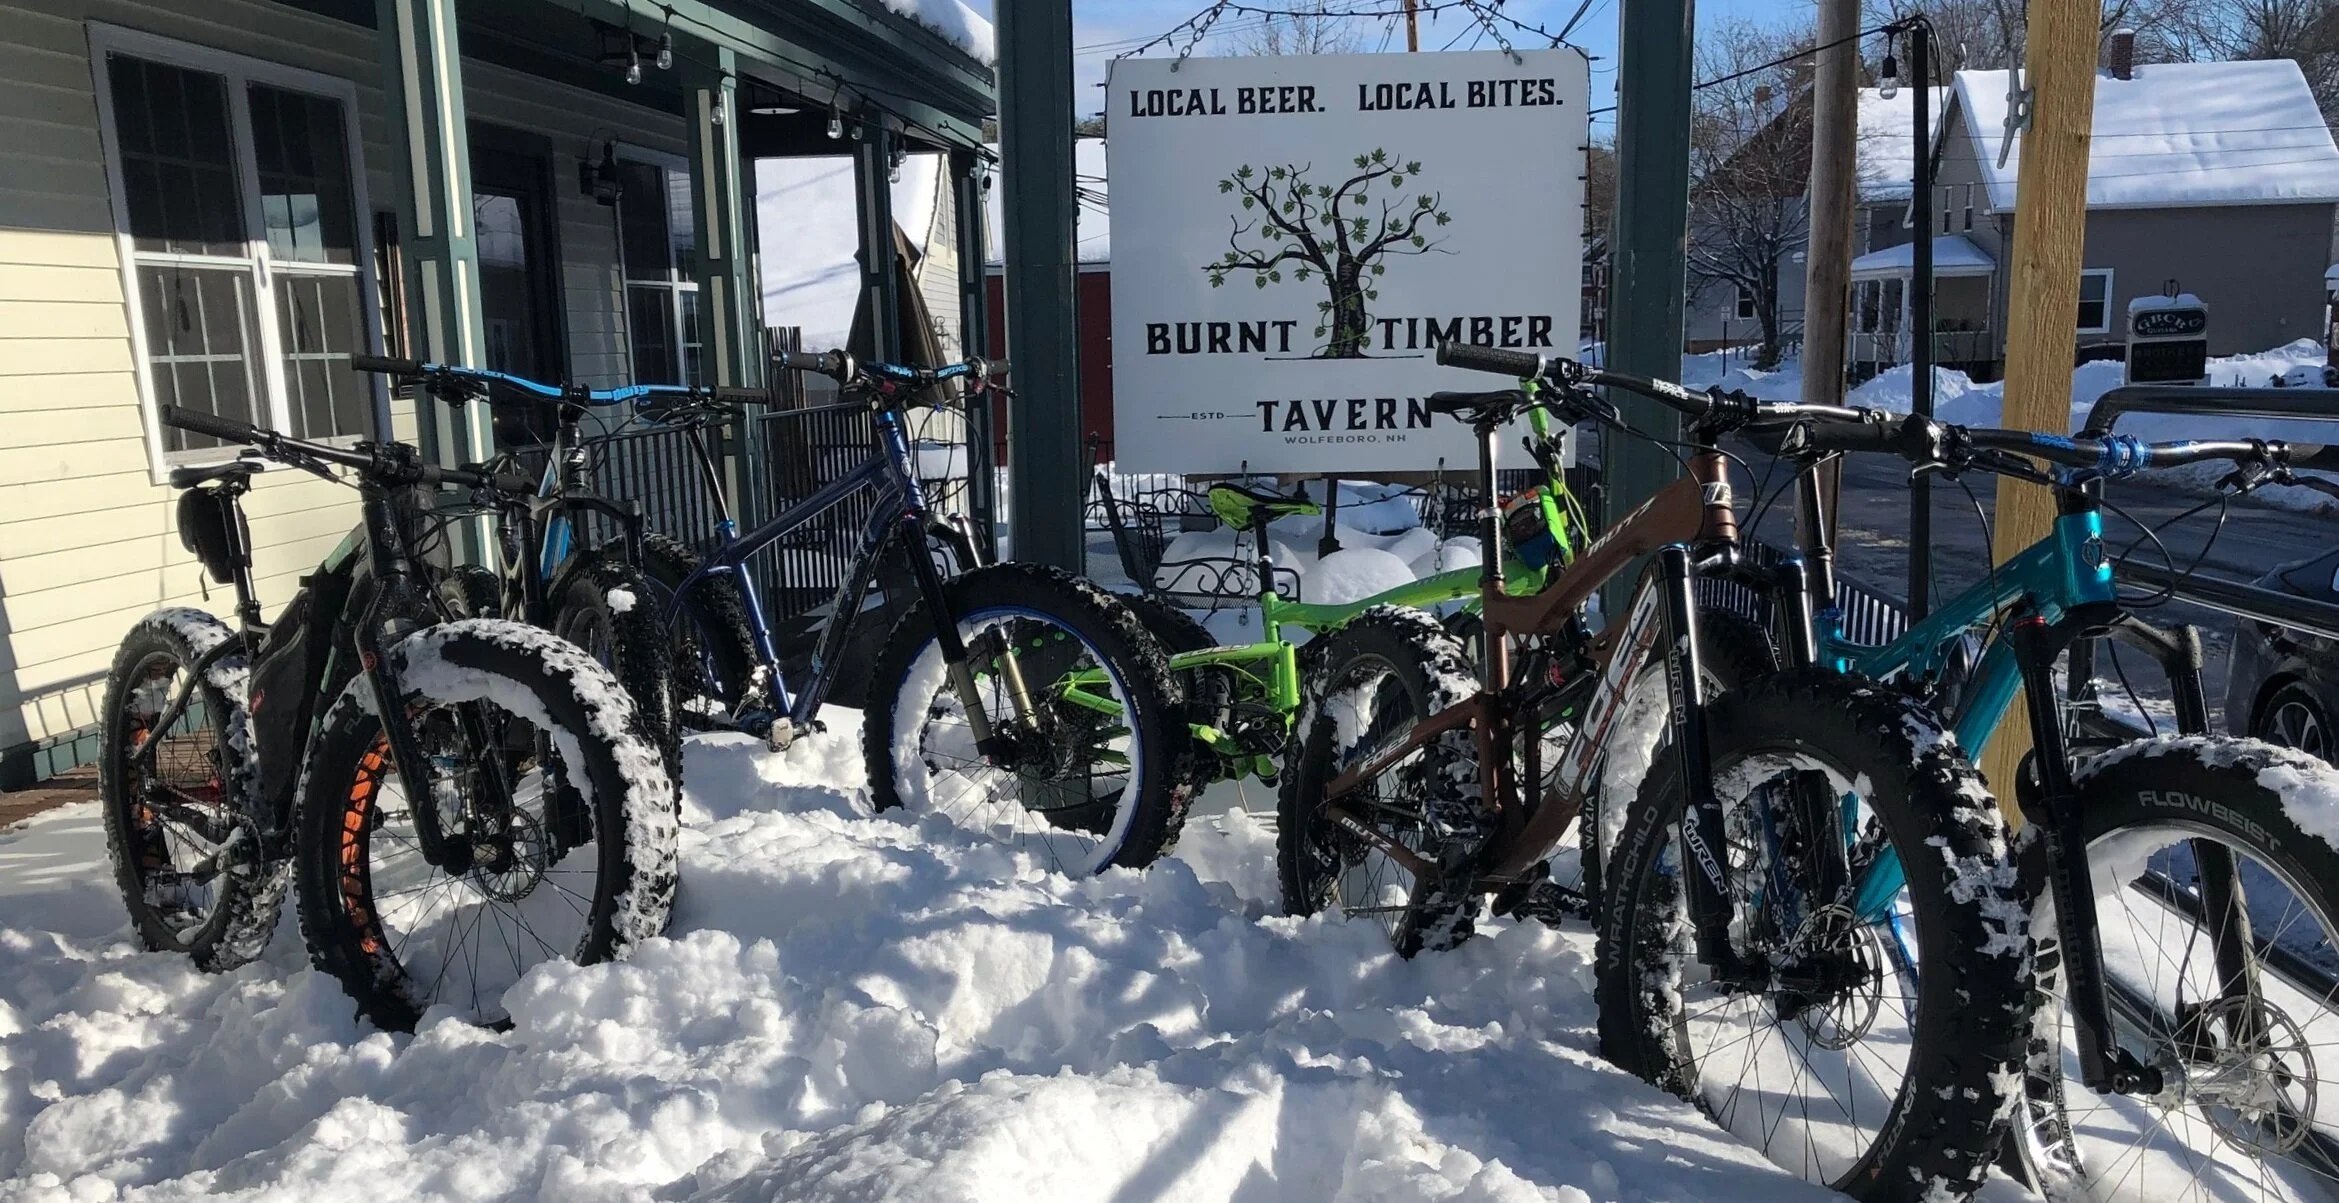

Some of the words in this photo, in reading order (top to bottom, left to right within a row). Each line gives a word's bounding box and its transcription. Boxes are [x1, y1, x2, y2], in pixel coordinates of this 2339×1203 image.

[1130, 88, 1226, 117] LOCAL
[1237, 86, 1325, 115] BEER.
[1358, 82, 1455, 111] LOCAL
[1467, 79, 1563, 107] BITES.
[1146, 320, 1297, 355] BURNT
[1376, 316, 1553, 350] TIMBER
[1191, 412, 1225, 420] ESTD
[1256, 398, 1432, 432] TAVERN
[1285, 435, 1381, 445] WOLFEBORO,
[1386, 434, 1407, 443] NH
[1668, 650, 1688, 726] WREN
[1584, 796, 1596, 850] WAZIA
[2137, 789, 2282, 852] FLOWBEIST
[1682, 820, 1729, 895] WREN
[1608, 804, 1660, 970] WRATHCHILD
